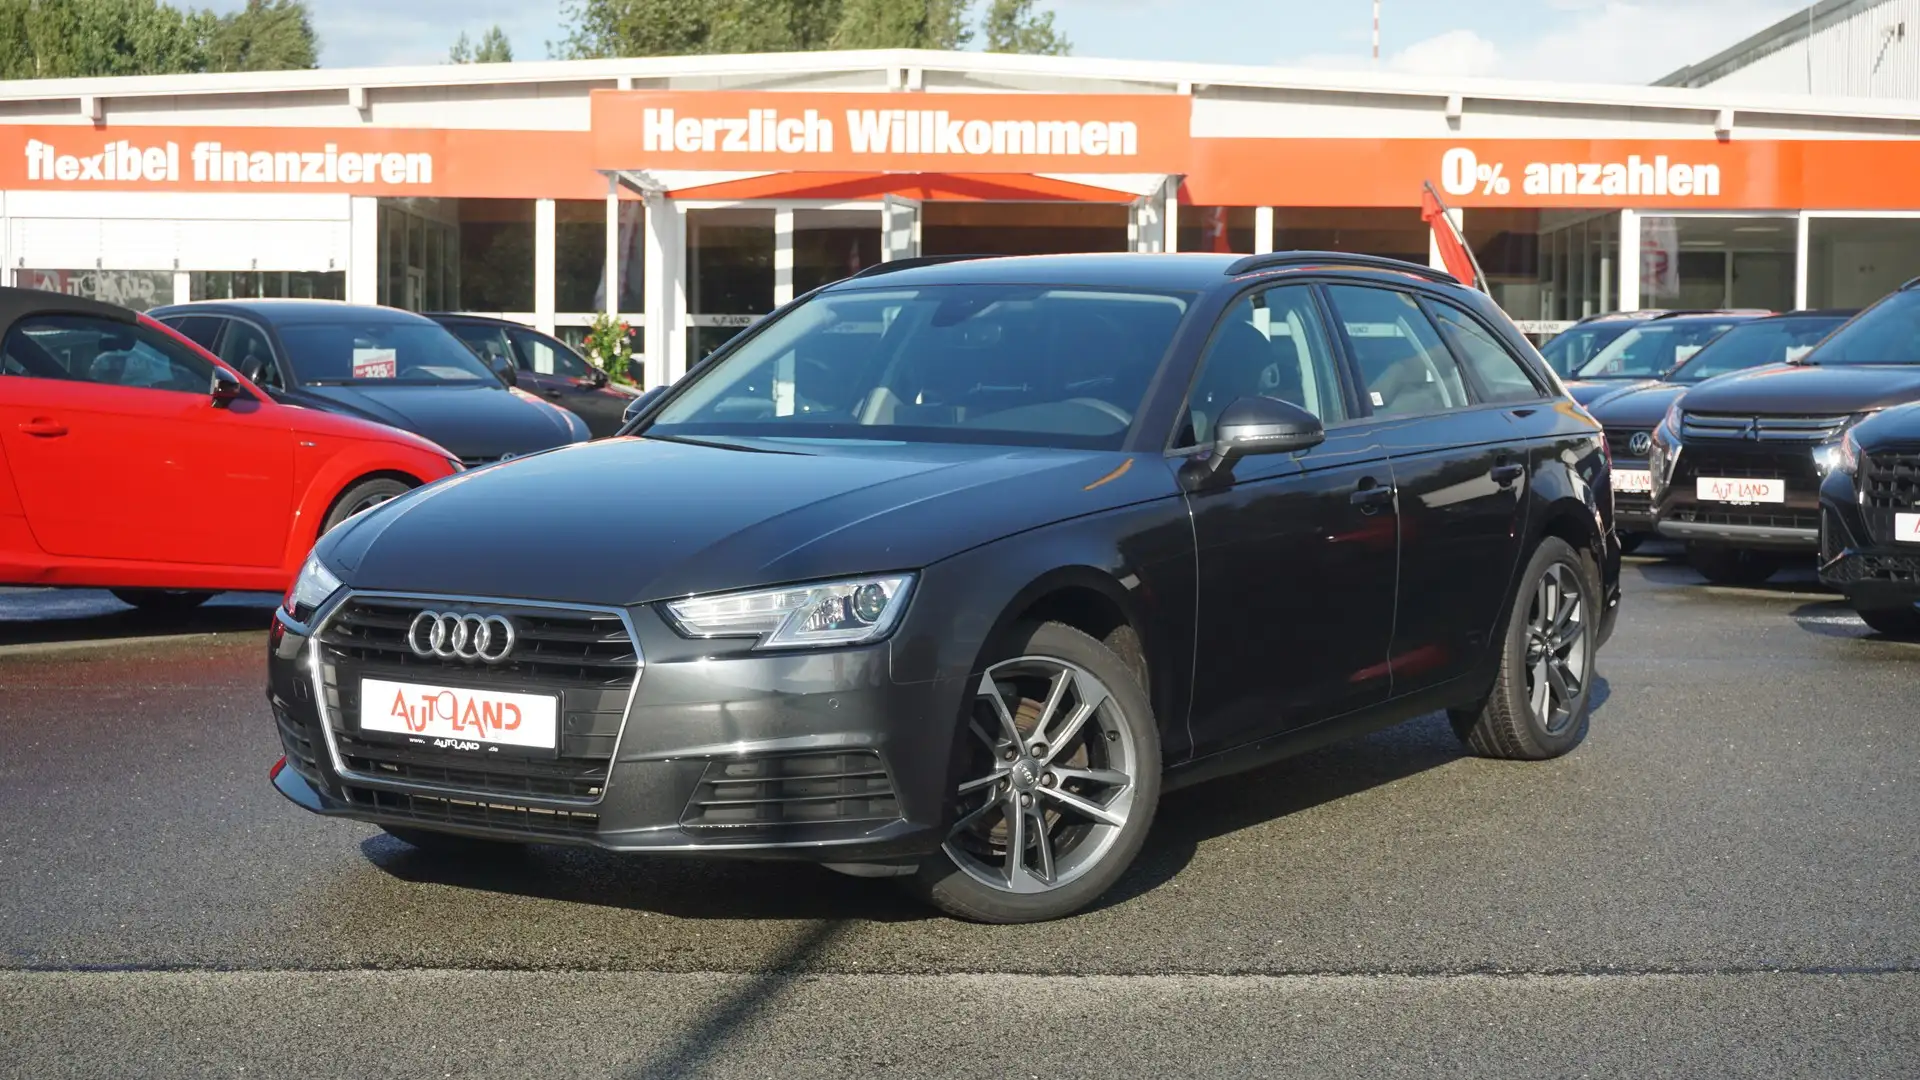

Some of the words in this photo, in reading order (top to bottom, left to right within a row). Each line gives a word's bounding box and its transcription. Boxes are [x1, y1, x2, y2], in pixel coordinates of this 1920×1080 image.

[643, 107, 834, 153] Herzlich
[847, 108, 1138, 156] Willkommen
[26, 139, 179, 182] flexibel
[192, 141, 432, 184] finanzieren
[1441, 147, 1510, 195] 0%
[1524, 154, 1720, 196] anzahlen
[1712, 481, 1769, 500] AUTLAND
[390, 687, 522, 738] AUTOLAND
[391, 688, 521, 738] www.
[433, 738, 480, 751] AUTOLAND
